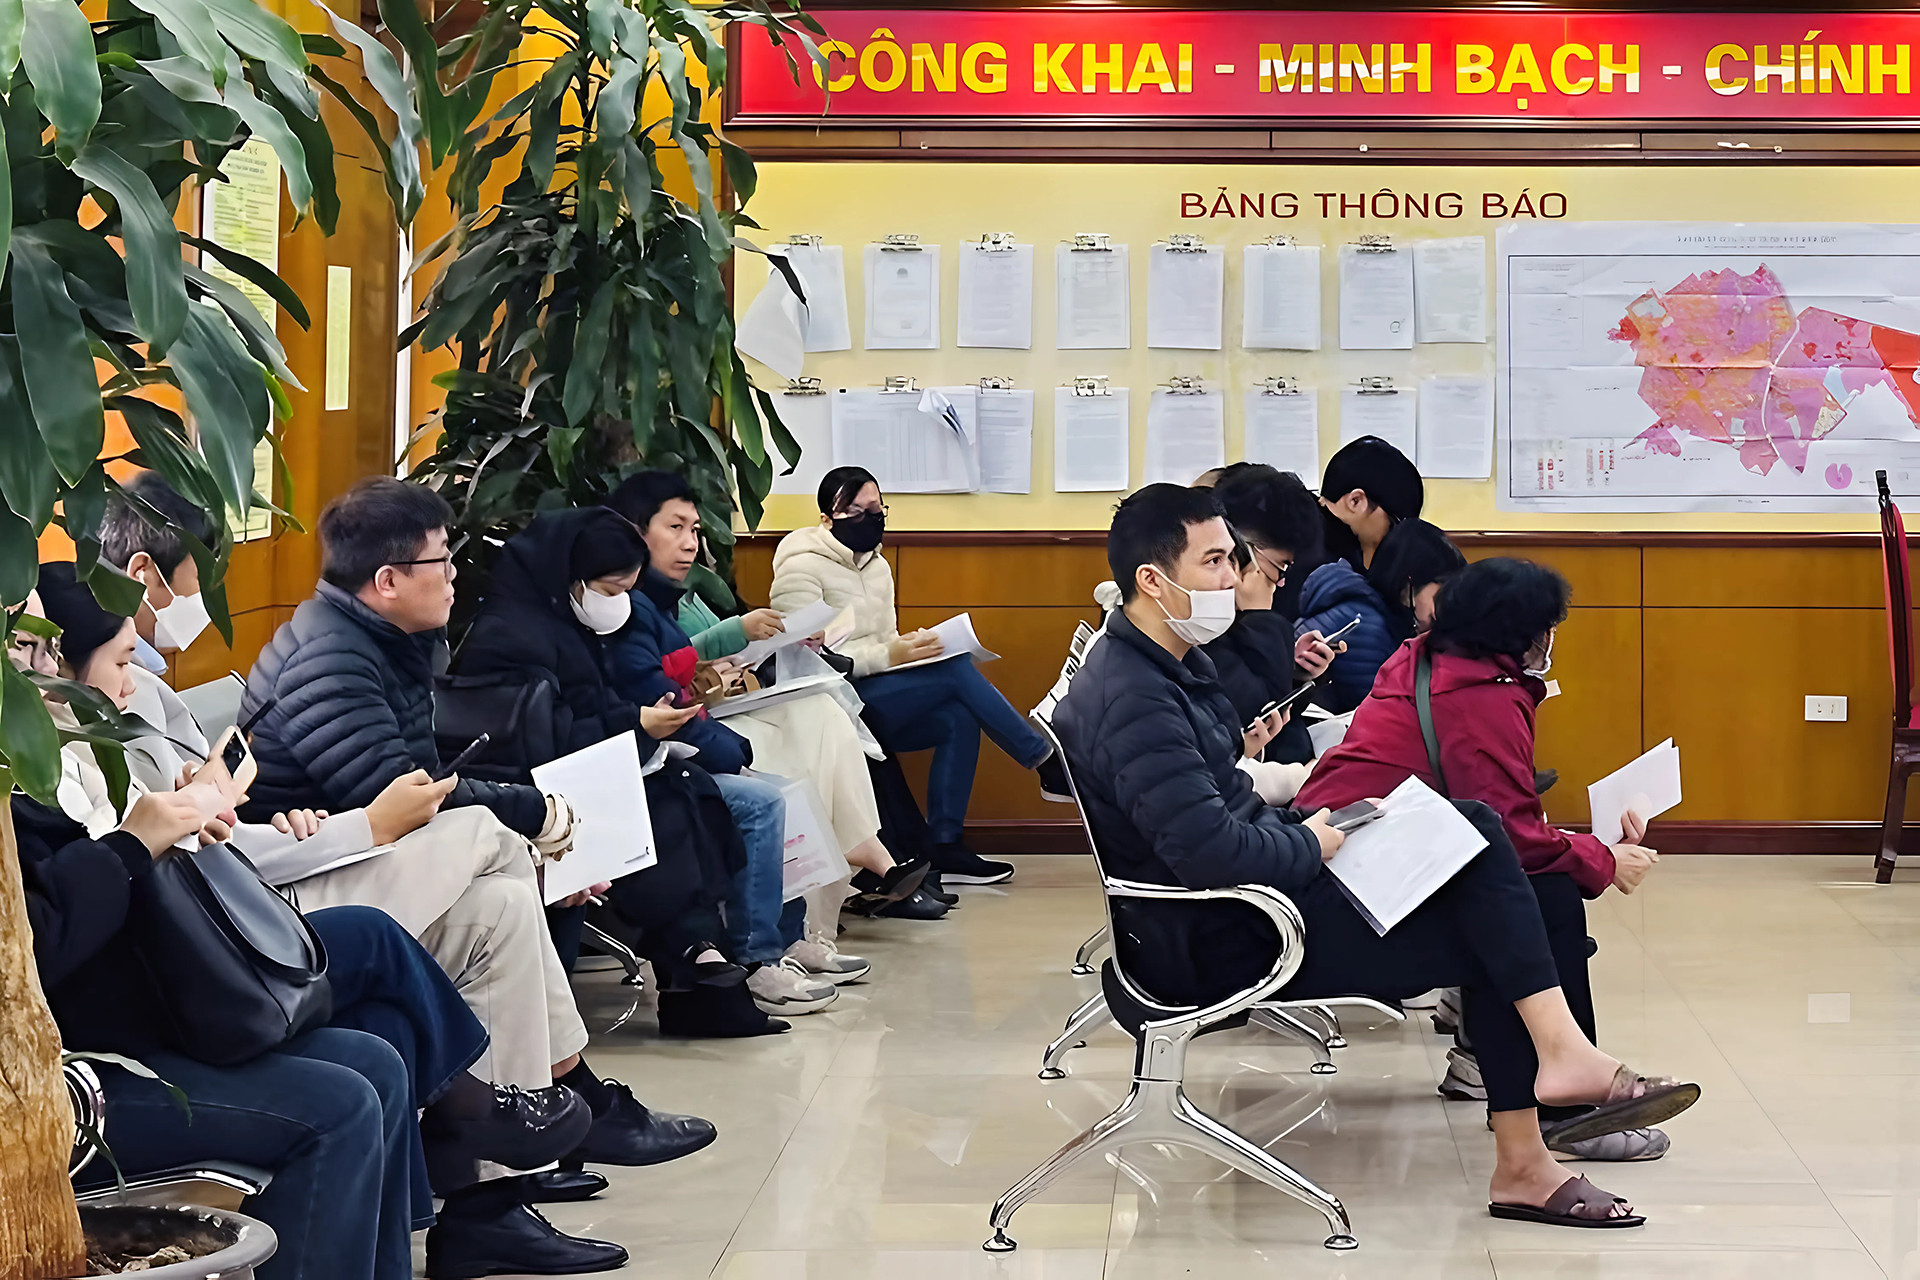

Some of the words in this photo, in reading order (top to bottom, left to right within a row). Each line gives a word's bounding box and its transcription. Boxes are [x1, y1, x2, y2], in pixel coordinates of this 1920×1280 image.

[813, 27, 1008, 94] CÔNG
[1033, 42, 1193, 94] KHAI
[1214, 63, 1236, 74] -
[1259, 42, 1432, 94] MINH
[1456, 43, 1640, 110] BẠCH
[1662, 64, 1682, 76] -
[1704, 30, 1911, 95] CHÍNH
[1179, 186, 1299, 219] BẢNG
[1314, 187, 1464, 219] THÔNG
[1482, 187, 1568, 219] BÁO
